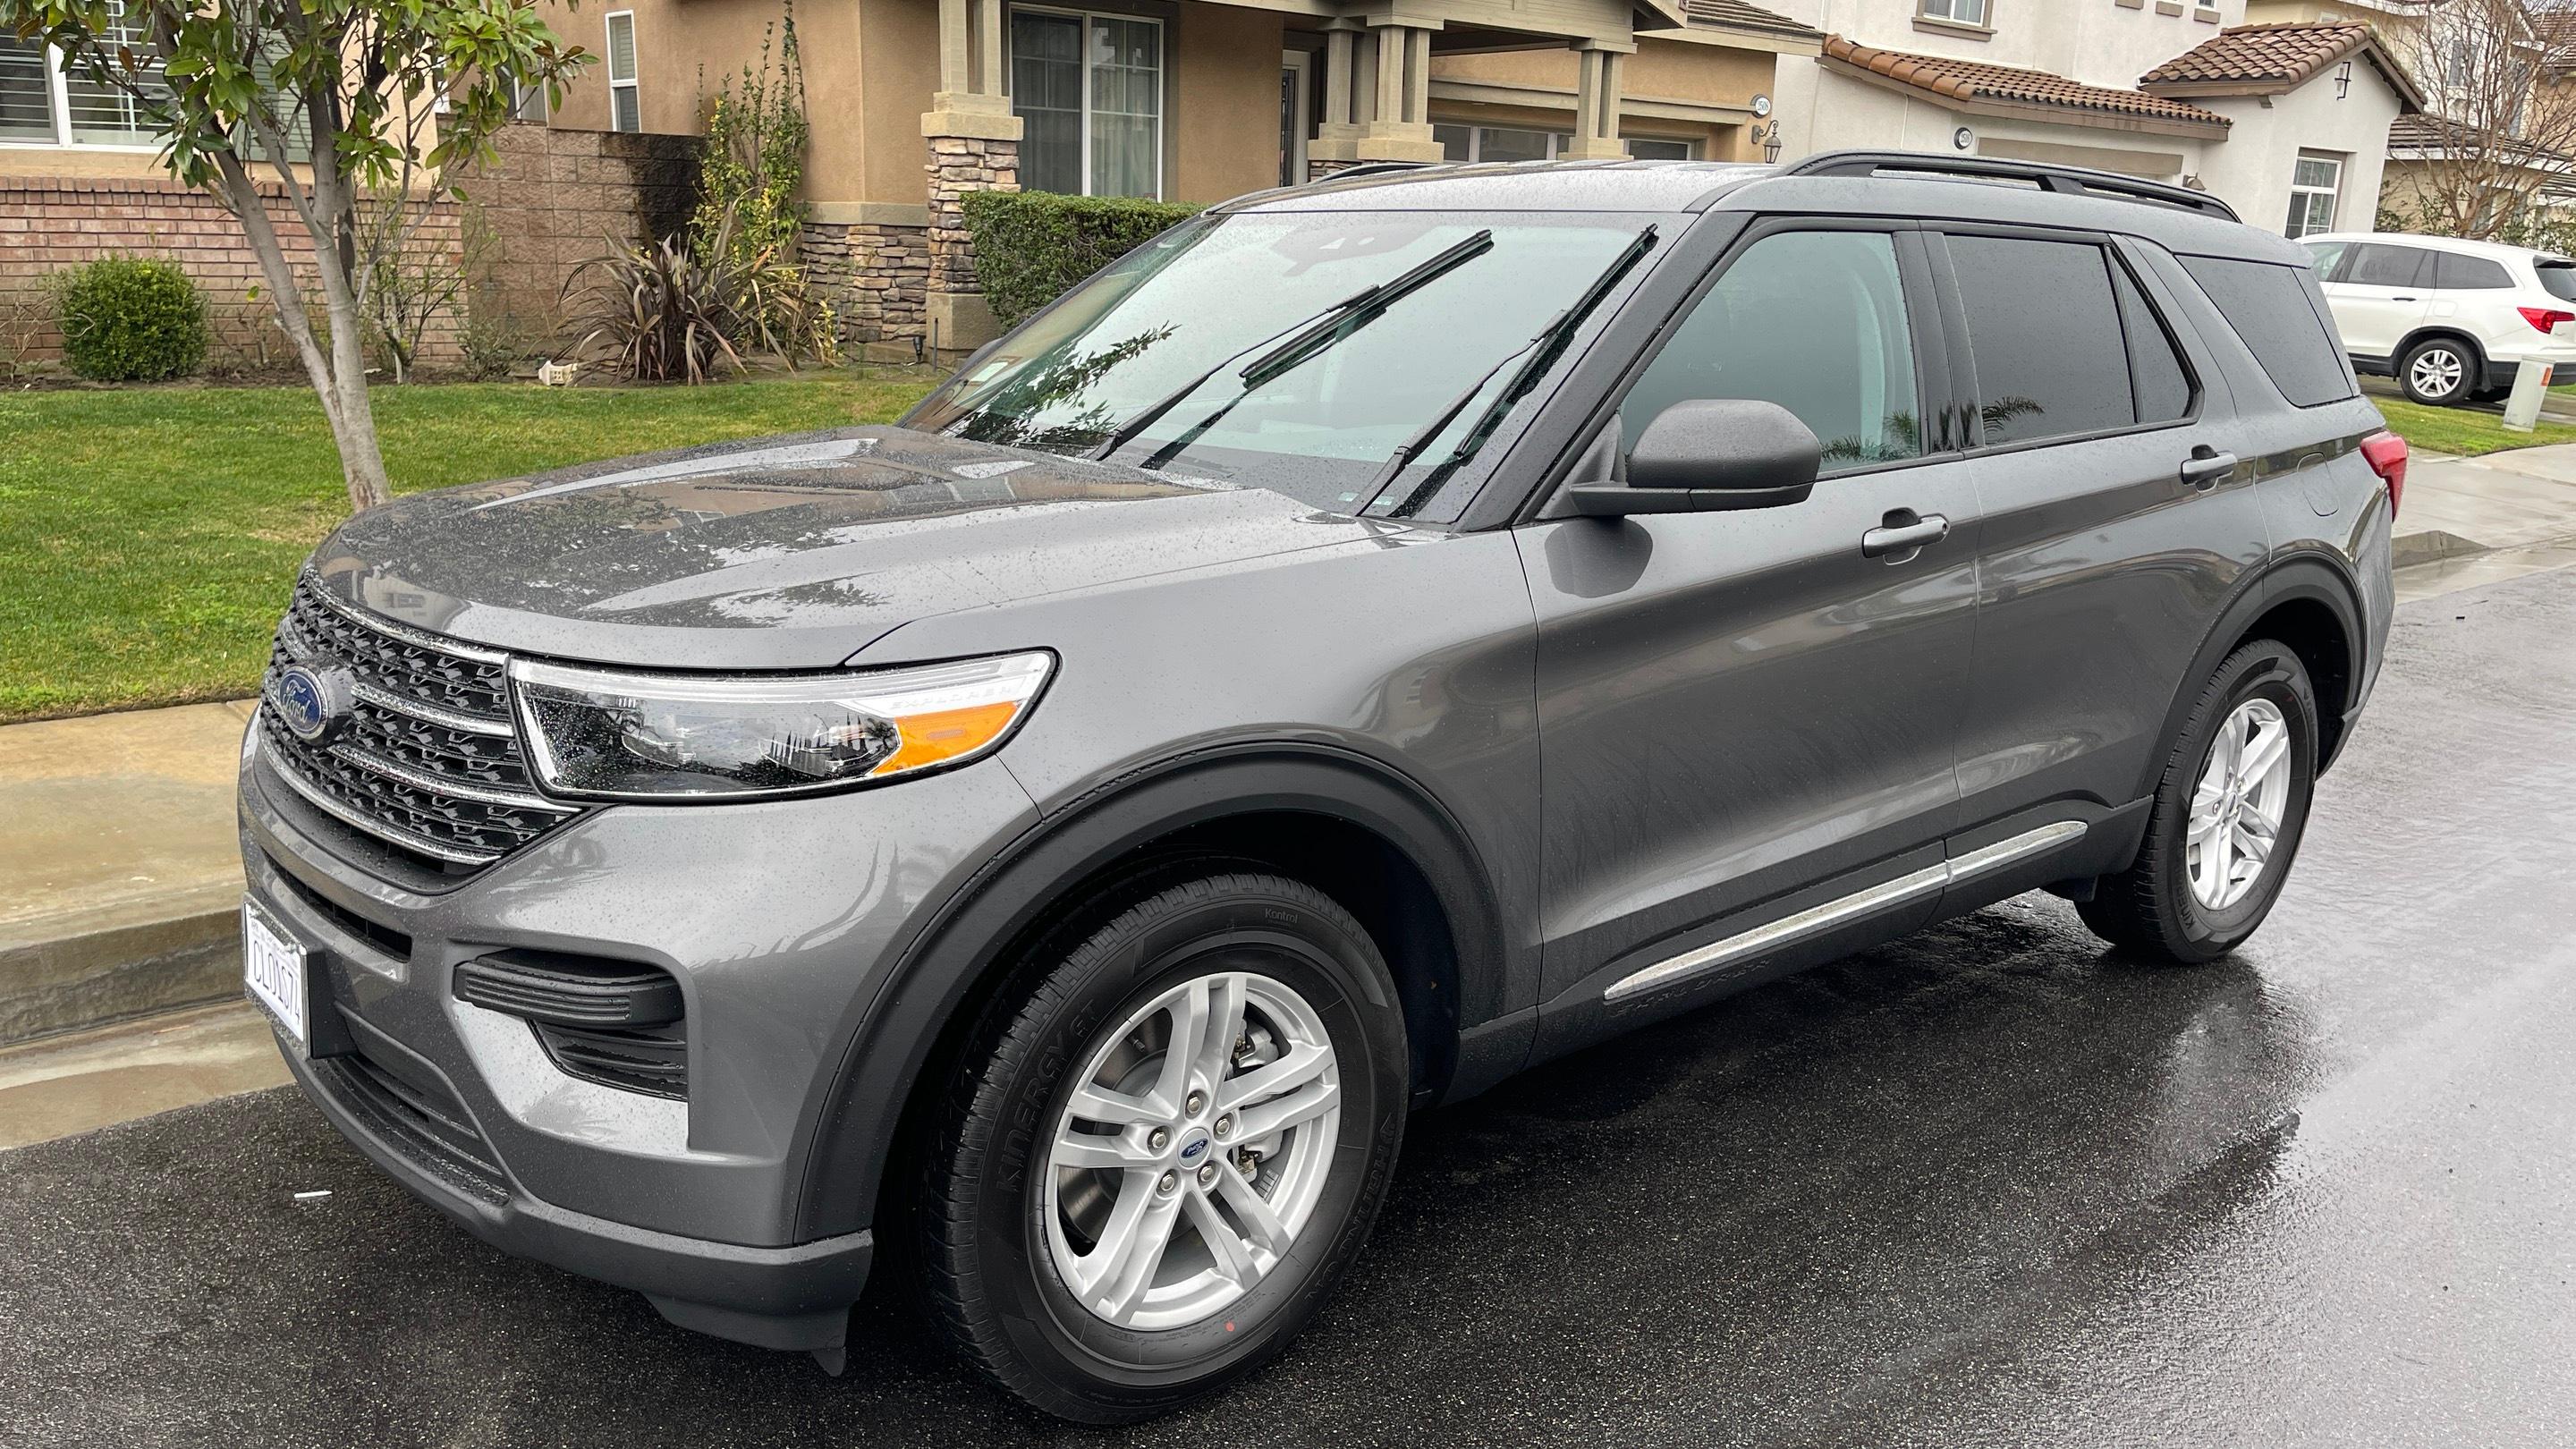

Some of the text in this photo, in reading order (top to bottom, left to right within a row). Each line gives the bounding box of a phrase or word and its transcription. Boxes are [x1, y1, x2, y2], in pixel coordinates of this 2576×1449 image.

[283, 679, 311, 724] Ford
[890, 686, 1011, 710] EXPLORER
[1265, 908, 1298, 924] Kontrol
[996, 1030, 1066, 1194] KINERGY
